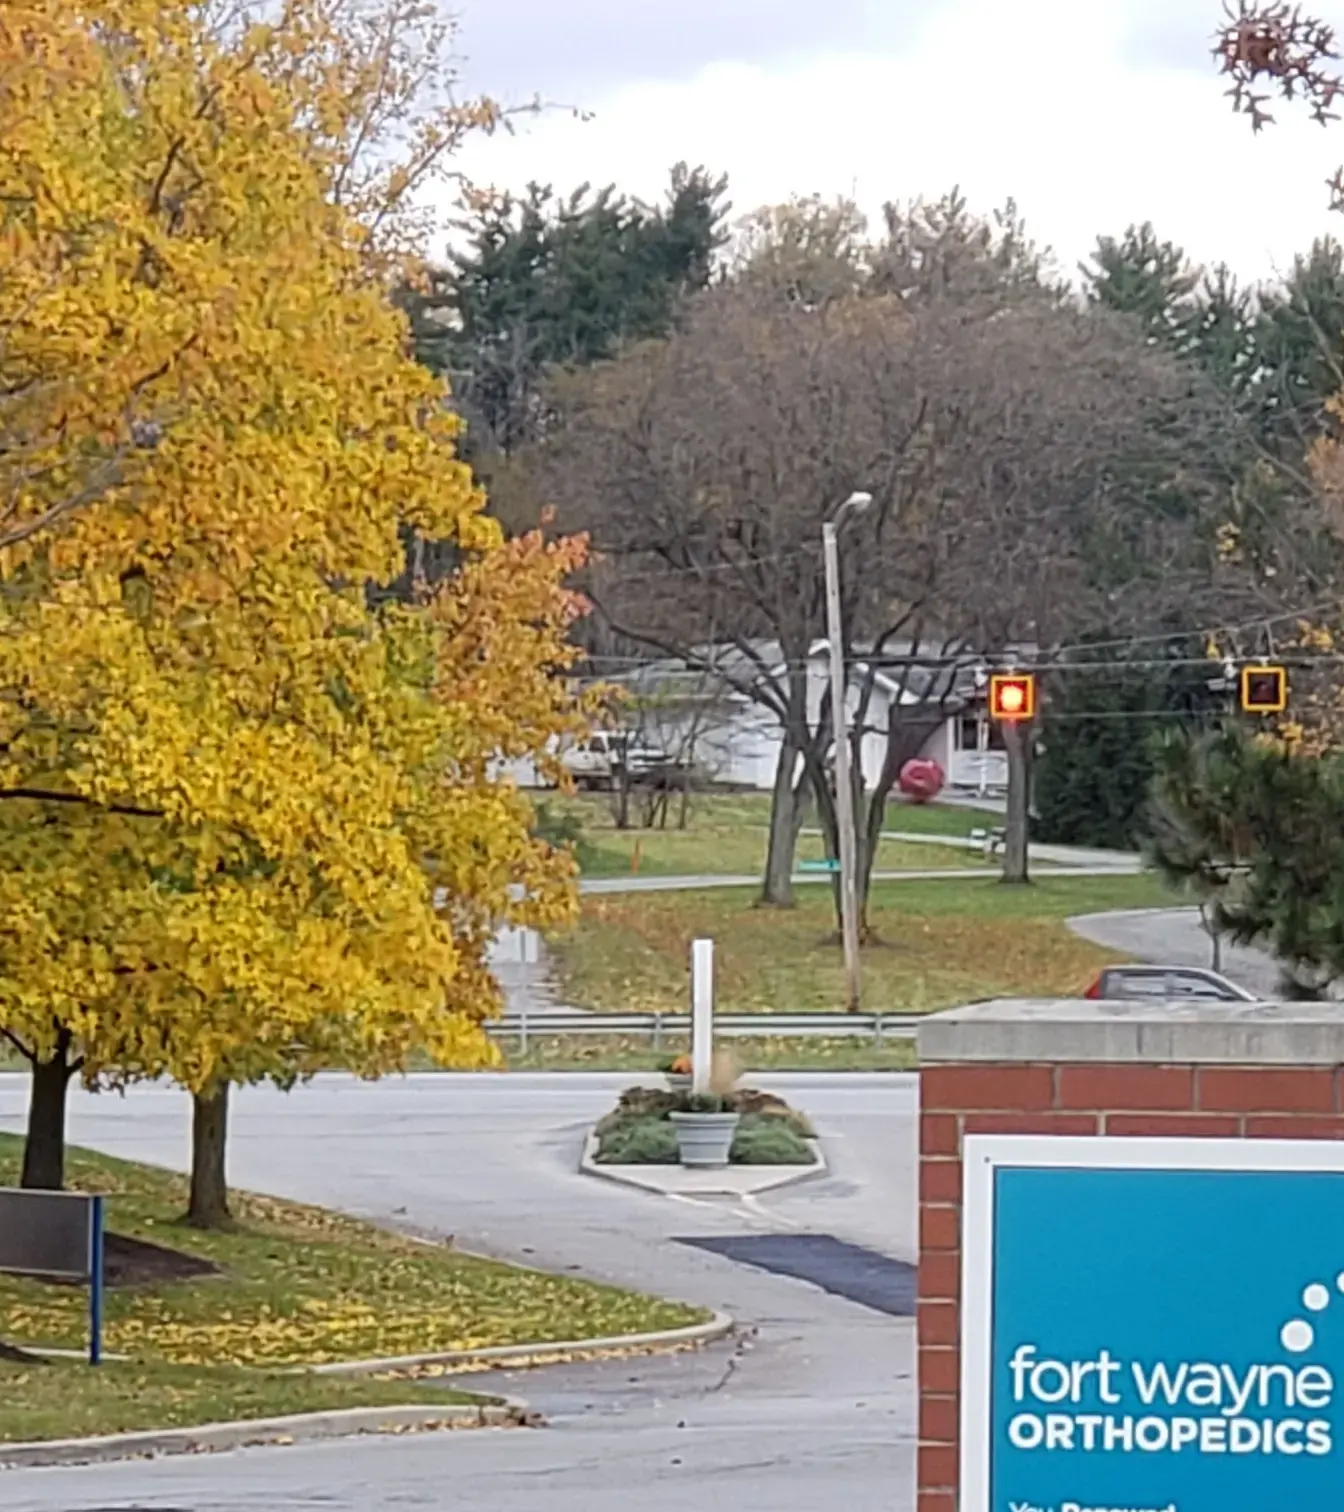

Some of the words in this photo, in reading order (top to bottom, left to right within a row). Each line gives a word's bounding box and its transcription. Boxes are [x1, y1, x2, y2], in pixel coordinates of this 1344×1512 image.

[1009, 1345, 1121, 1403] fort
[1131, 1360, 1334, 1416] wayne
[1008, 1414, 1332, 1455] ORTHOPEDICS
